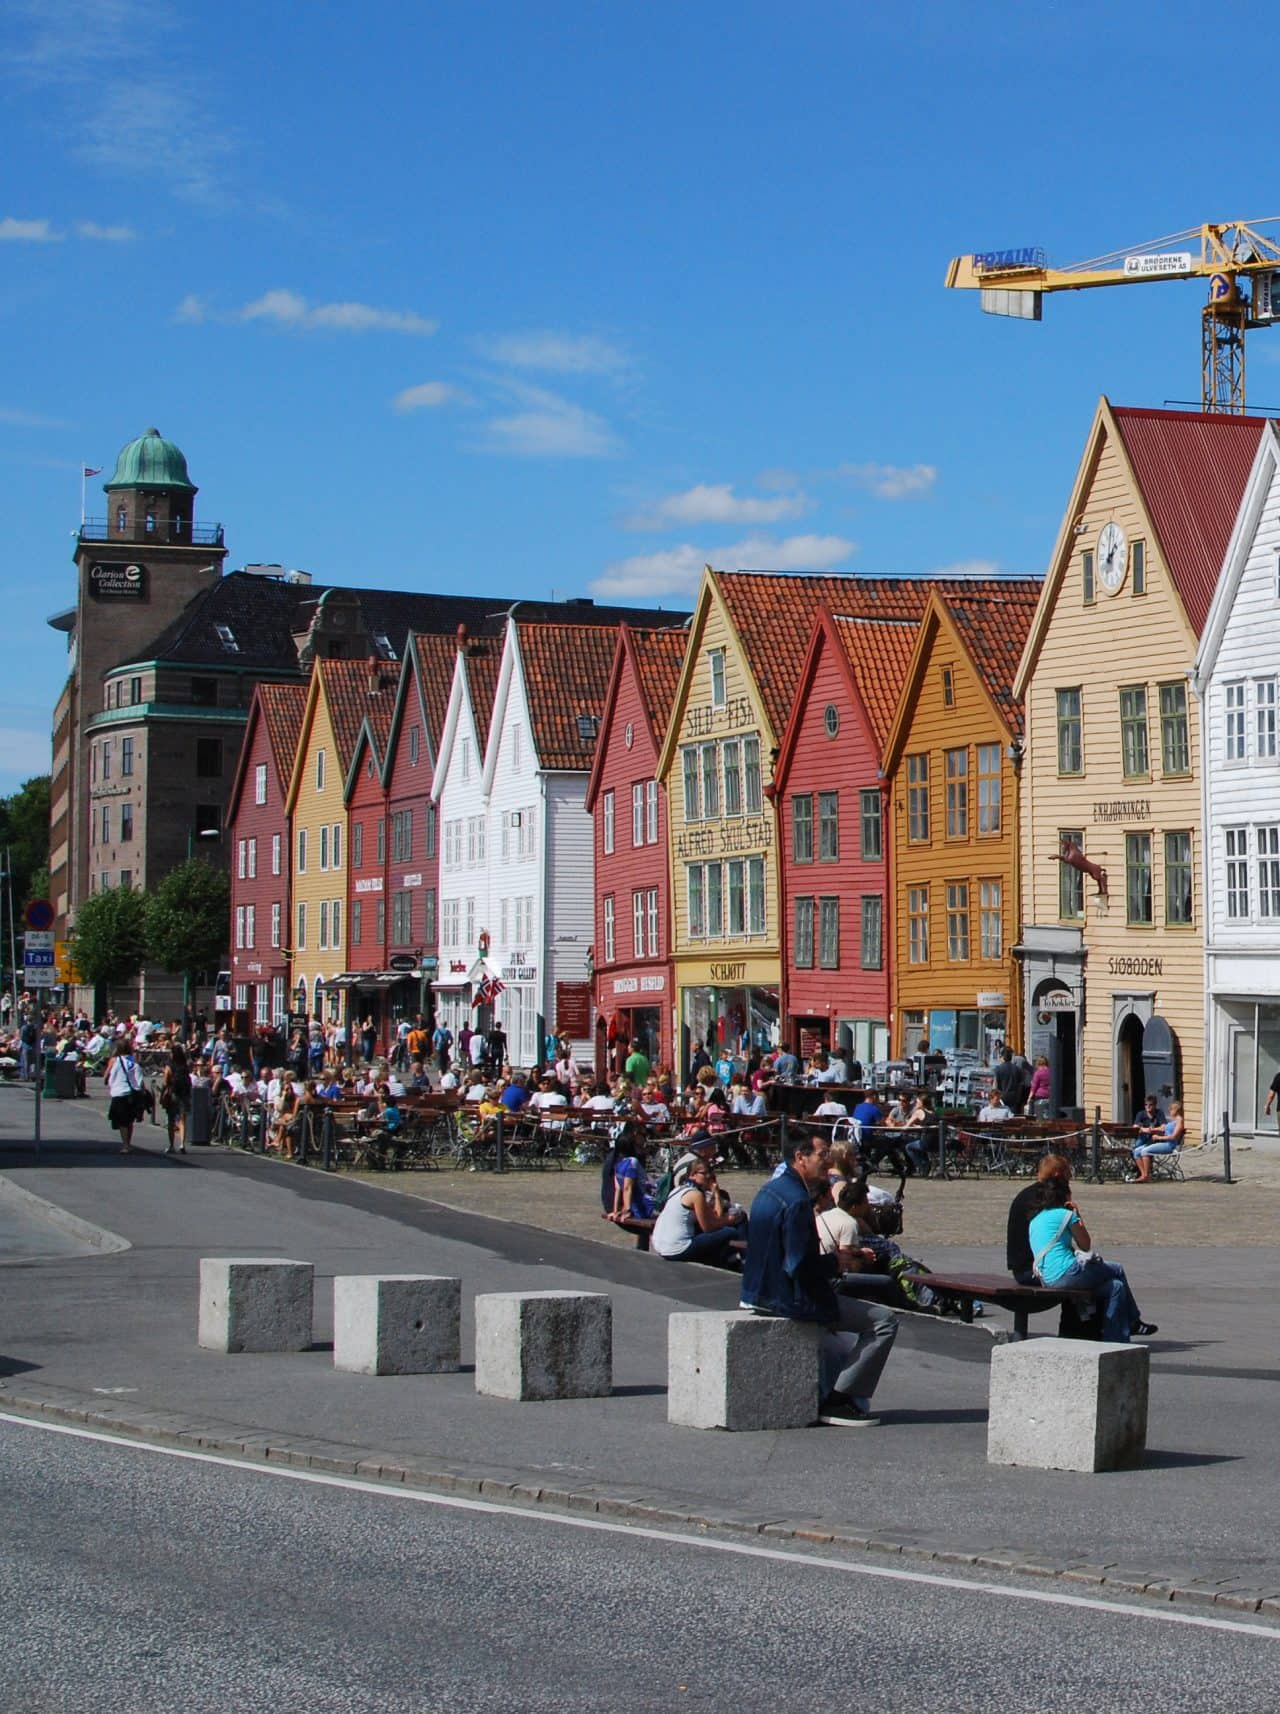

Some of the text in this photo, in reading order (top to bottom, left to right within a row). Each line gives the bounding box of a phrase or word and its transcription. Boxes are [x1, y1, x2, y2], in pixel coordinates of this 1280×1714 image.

[91, 565, 125, 579] Clarion
[98, 579, 141, 589] Collection
[686, 706, 713, 738] SILD
[677, 828, 714, 858] ALFRED
[27, 952, 53, 964] Taxi
[710, 962, 747, 980] SCHJØTT
